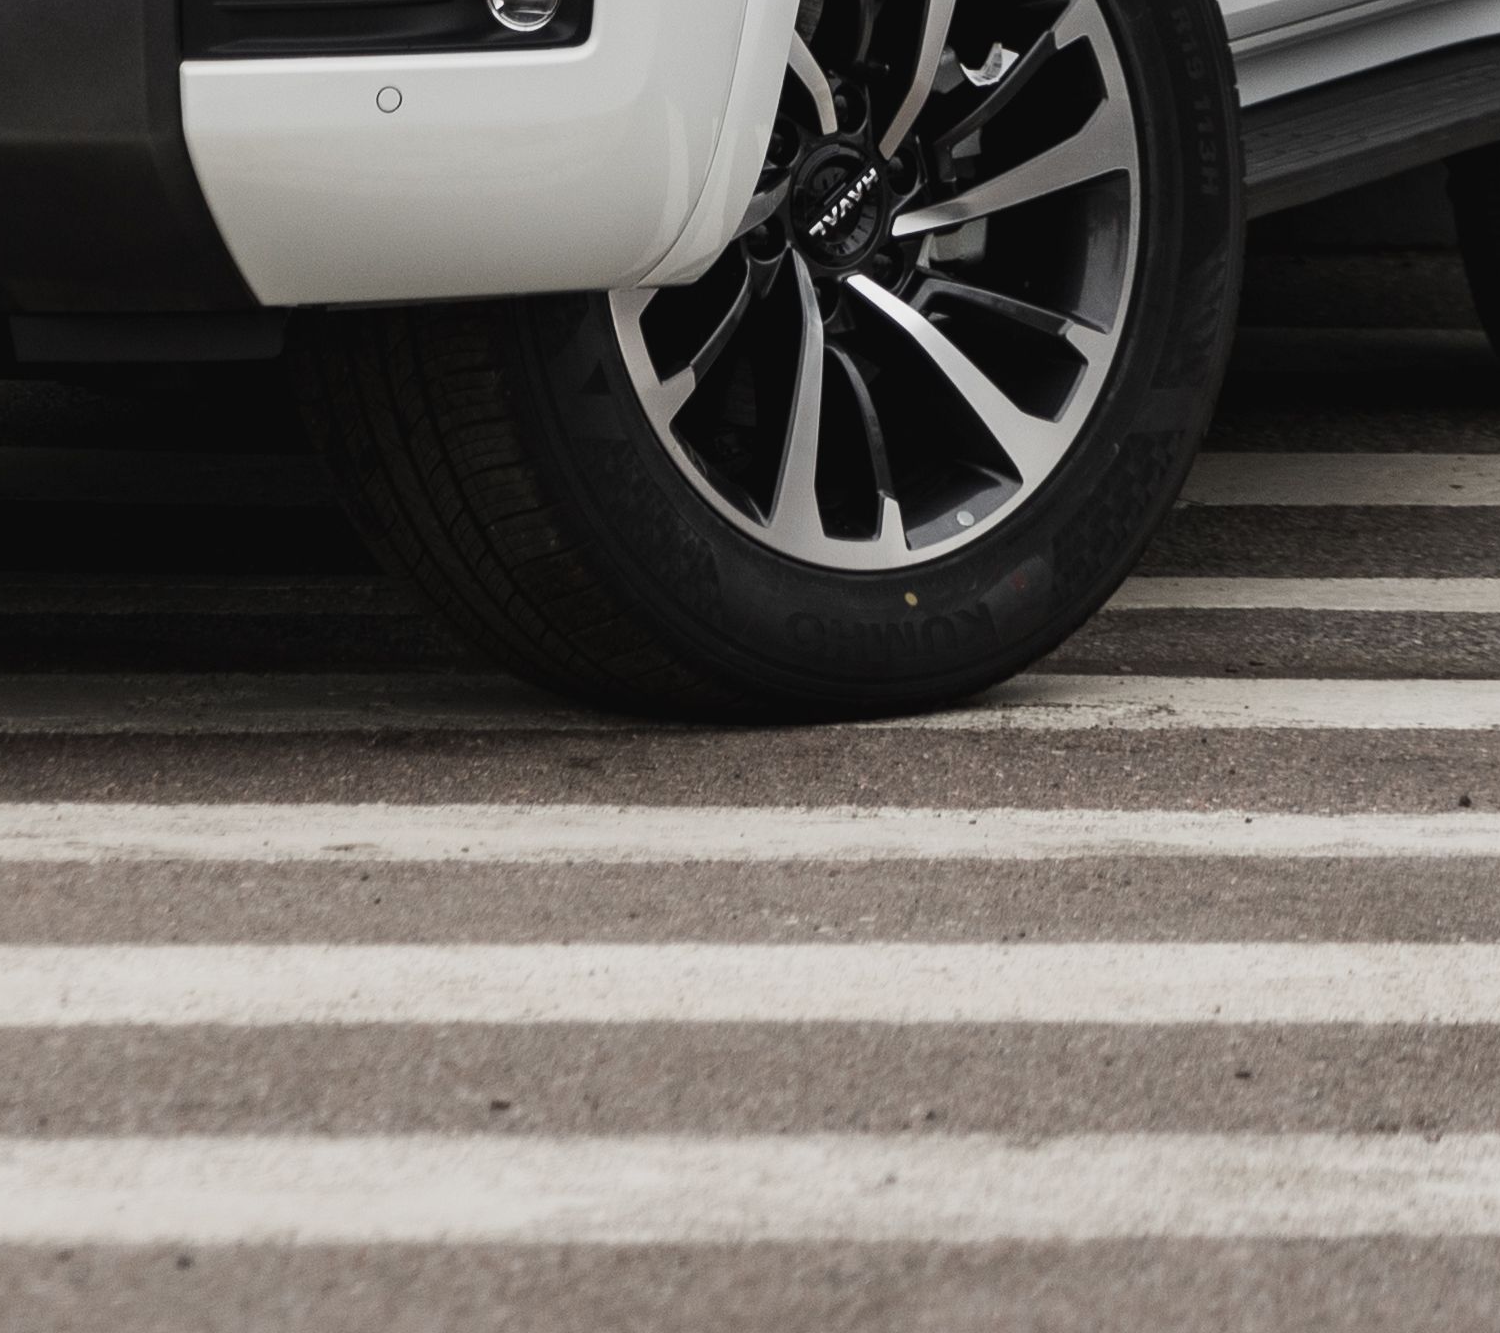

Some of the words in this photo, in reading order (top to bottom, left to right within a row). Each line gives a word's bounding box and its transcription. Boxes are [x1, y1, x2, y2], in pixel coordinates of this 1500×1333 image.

[1169, 6, 1205, 80] R19
[808, 166, 879, 237] HAVAL
[784, 602, 1000, 659] KUMHO
